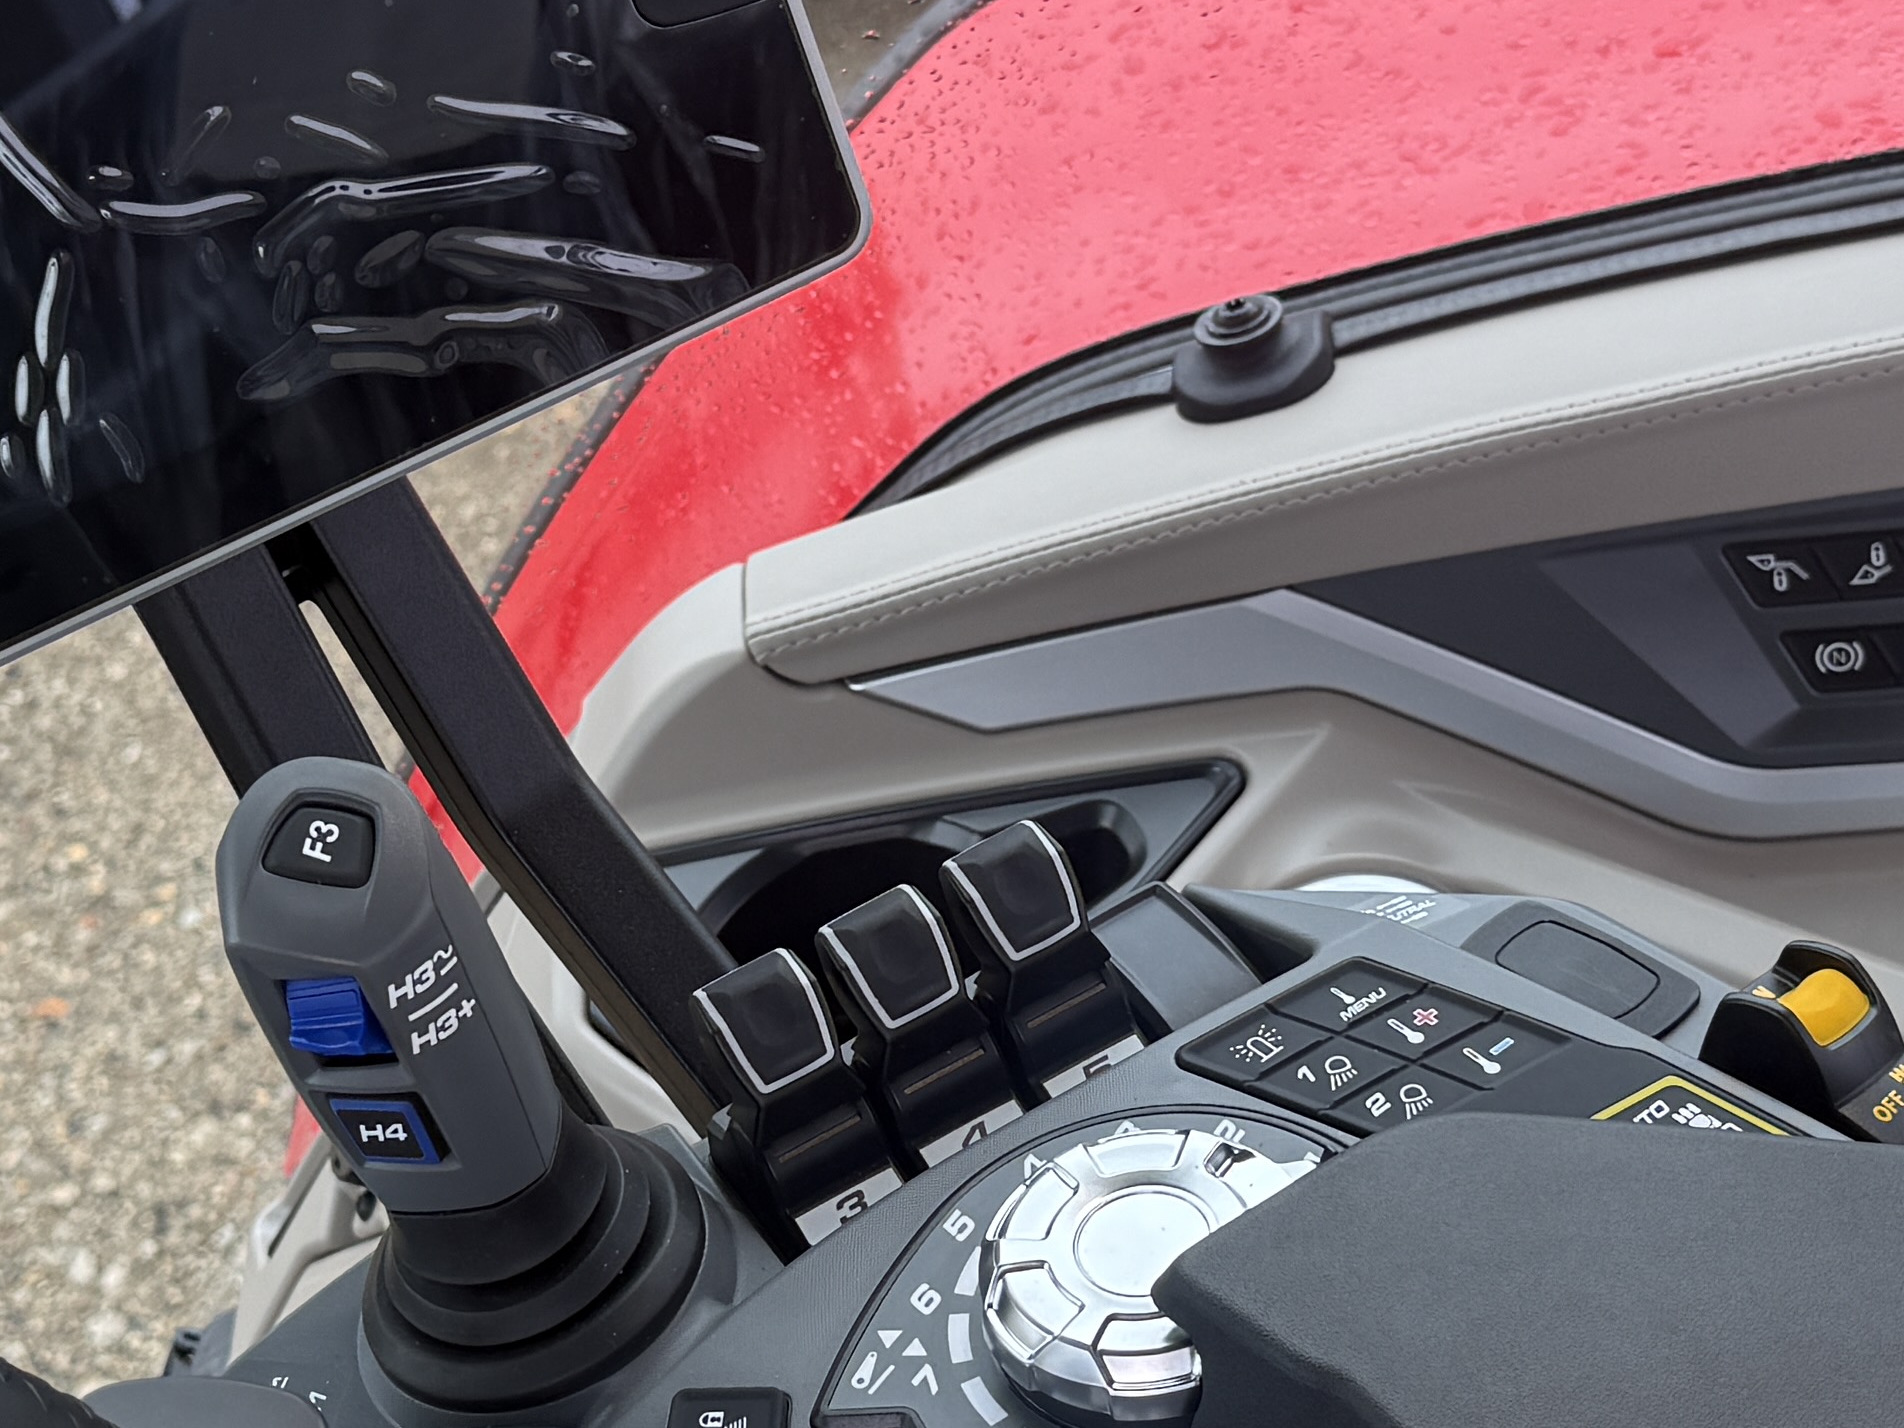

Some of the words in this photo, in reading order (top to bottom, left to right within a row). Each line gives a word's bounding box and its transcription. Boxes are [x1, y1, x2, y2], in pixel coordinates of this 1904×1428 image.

[302, 819, 340, 863] F3
[1339, 987, 1386, 1022] MENU
[1297, 1065, 1316, 1082] 1
[1365, 1092, 1392, 1118] 2
[1873, 1090, 1904, 1123] OFF
[359, 1123, 407, 1143] H4
[836, 1189, 869, 1225] 3
[942, 1209, 976, 1242] 5
[910, 1283, 942, 1315] 6
[911, 1362, 940, 1395] 7
